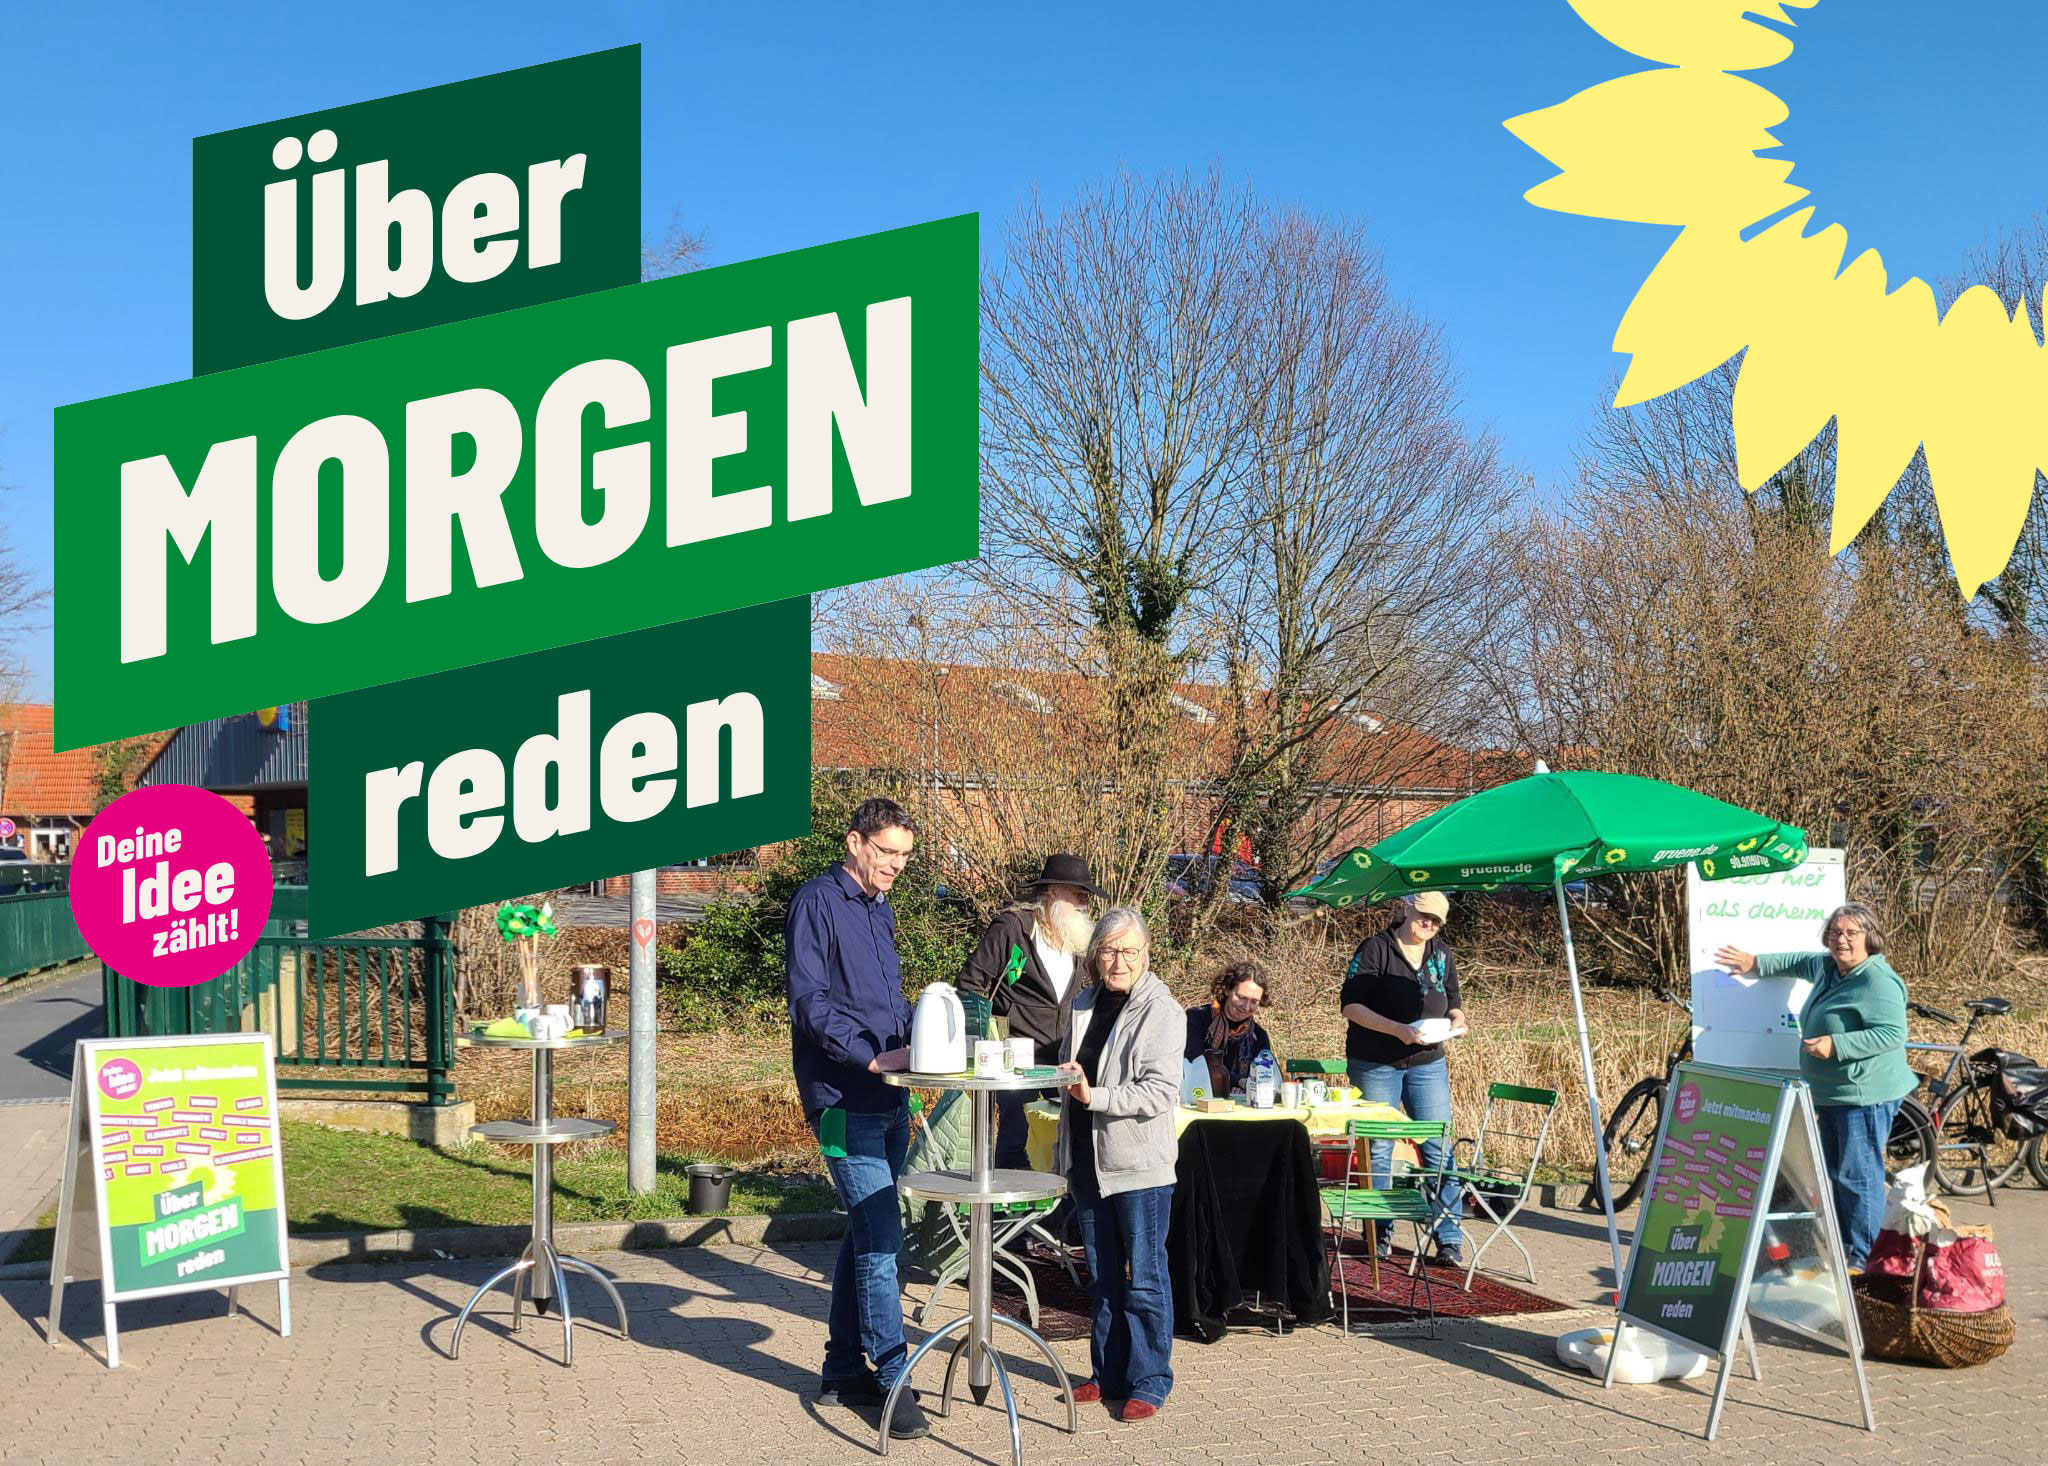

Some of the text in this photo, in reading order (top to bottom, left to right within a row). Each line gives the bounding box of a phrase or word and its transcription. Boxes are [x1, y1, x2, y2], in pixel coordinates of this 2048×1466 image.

[1651, 844, 1719, 862] gruene.de
[1460, 863, 1533, 878] gruene.de
[1706, 899, 1827, 920] als daheim
[1701, 1099, 1724, 1116] Jetzt
[1723, 1103, 1772, 1125] mitmachen
[146, 1203, 239, 1258] MORGEN
[1671, 1228, 1698, 1250] Über
[1651, 1260, 1716, 1287] MORGEN
[1661, 1300, 1694, 1319] reden
